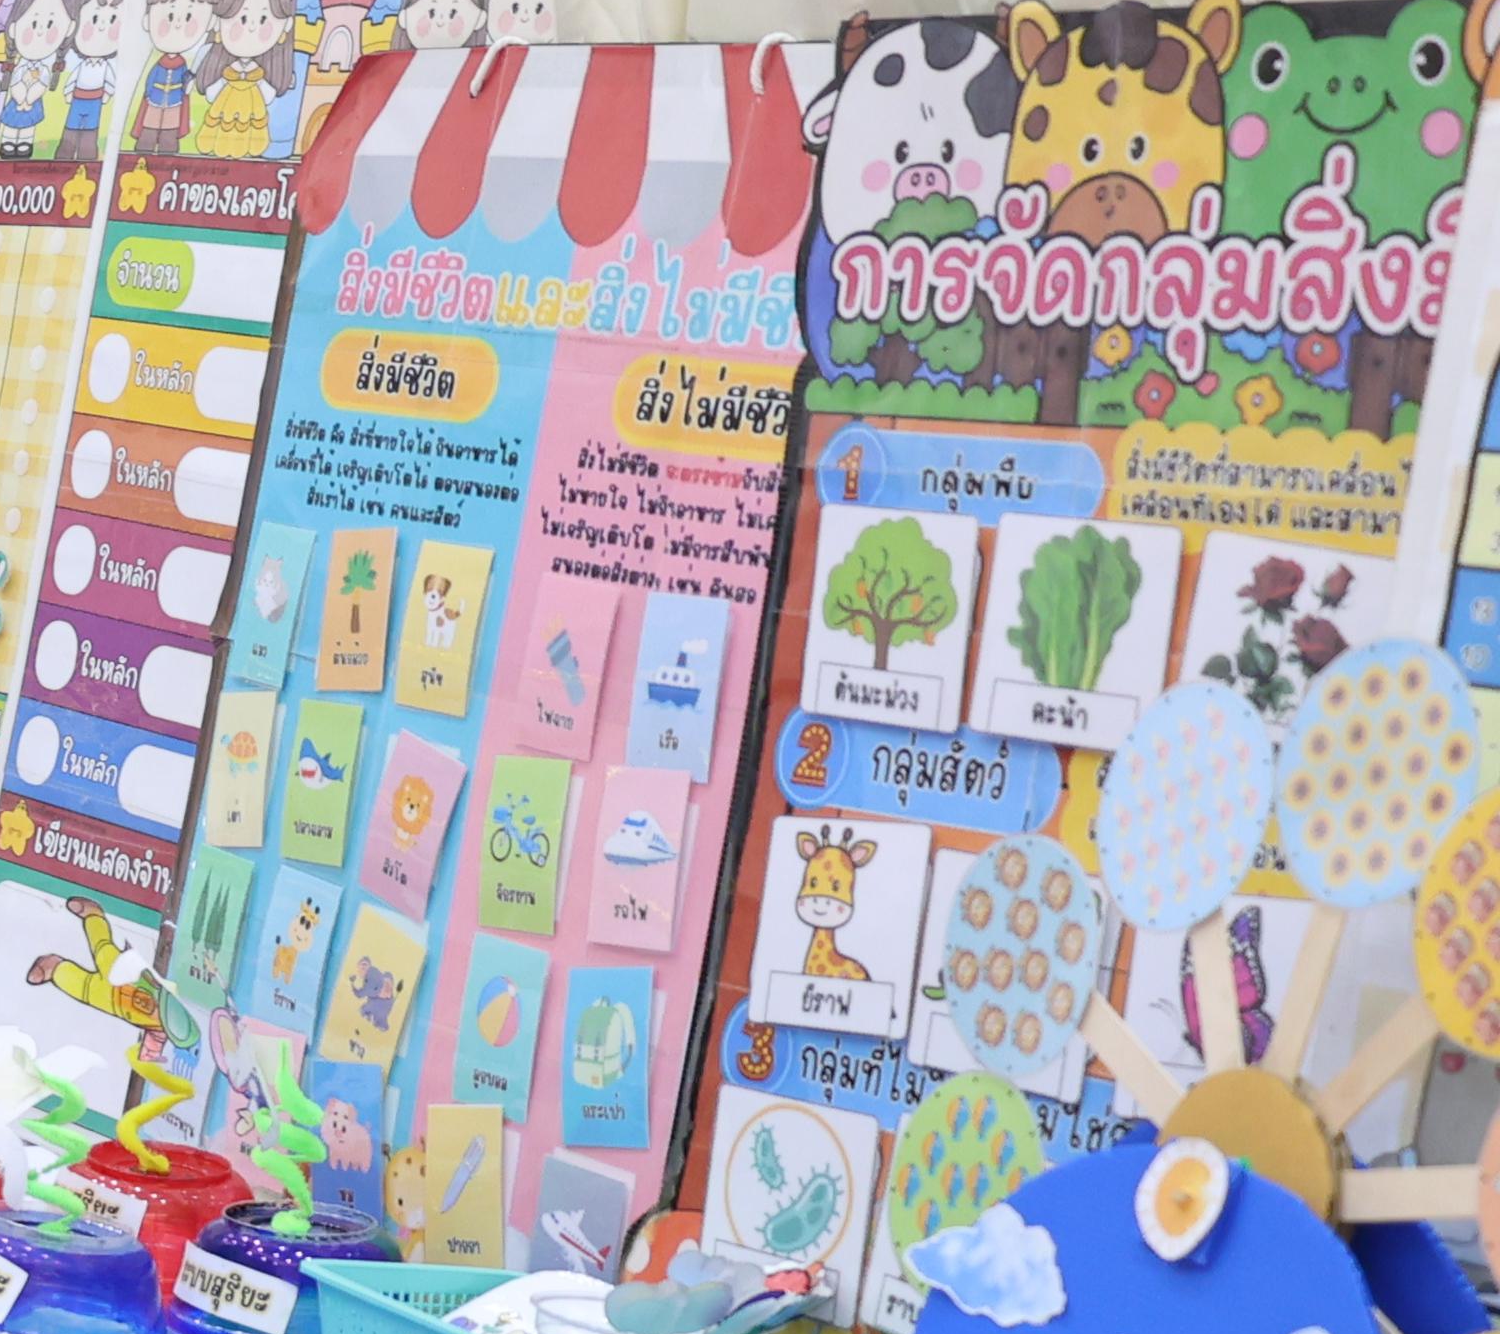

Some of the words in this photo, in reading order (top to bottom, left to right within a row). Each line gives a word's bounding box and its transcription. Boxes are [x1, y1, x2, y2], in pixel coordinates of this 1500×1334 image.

[159, 167, 297, 221] ค่าของเลขโ
[117, 251, 180, 294] จำนวน
[335, 222, 802, 350] สิ่งมีชีวิตและสิ่งไม่มีชี
[134, 350, 194, 395] ในหลัก
[356, 334, 455, 401] สิ่งมีชีวิต
[635, 360, 791, 437] สิ่งไม่มีชีวิ
[114, 449, 174, 494] ในหลัก
[918, 452, 1034, 515] กลุ่มพืช
[97, 546, 158, 595] ในหลัก
[79, 642, 139, 692] ในหลัก
[834, 668, 920, 714] ต้นมะม่วง
[1031, 693, 1089, 732] คะน้า
[61, 741, 118, 788] ในหลัก
[792, 722, 830, 786] 2
[872, 726, 1011, 808] กลุ่มสัตว์
[800, 986, 851, 1018] ยีราฟ
